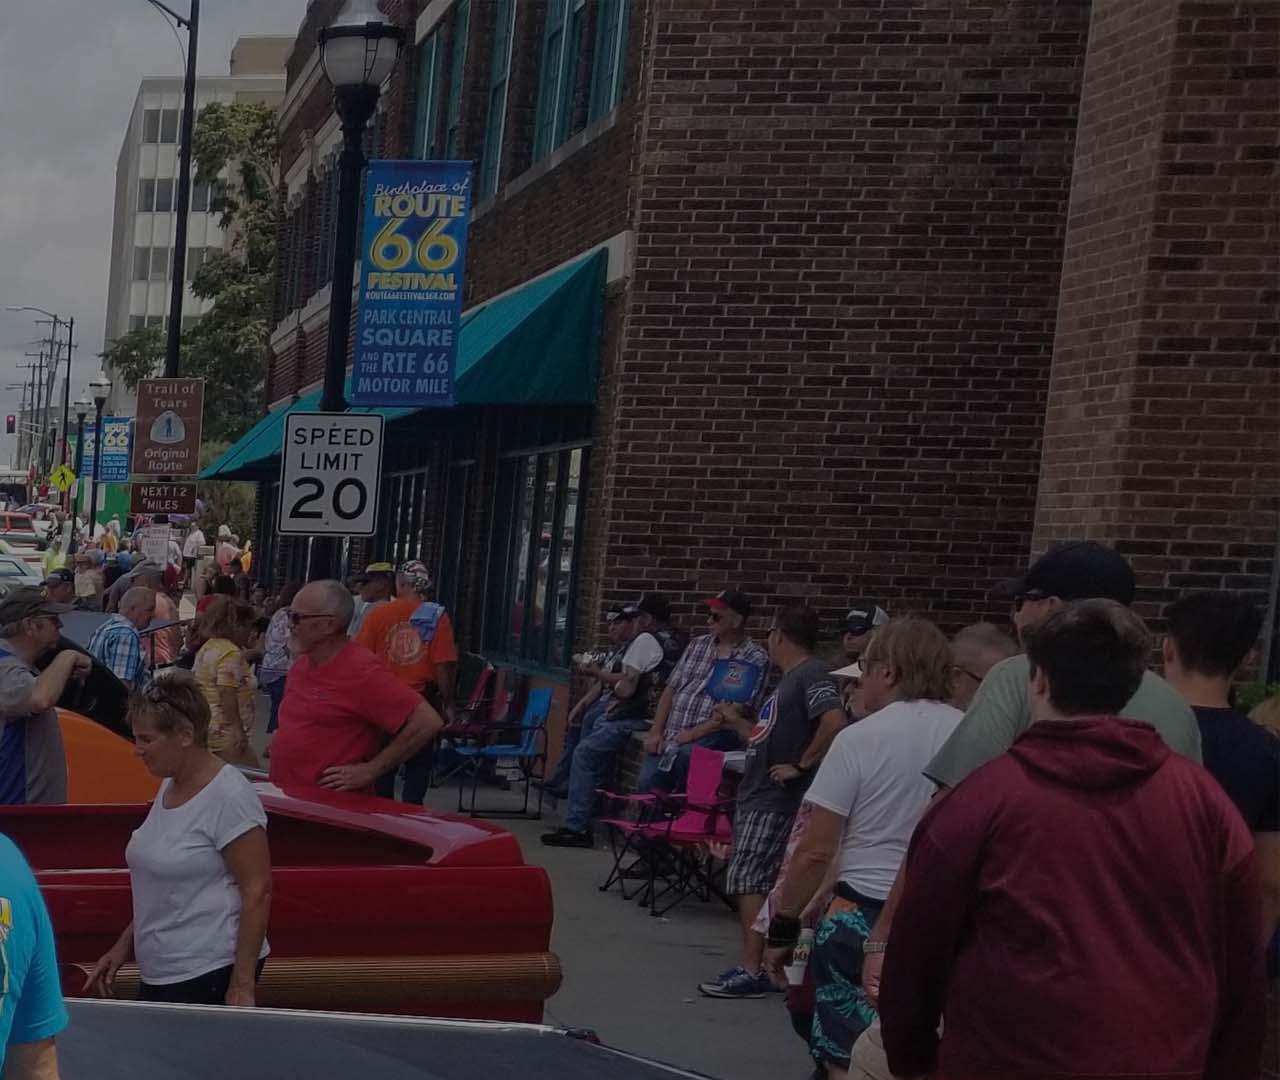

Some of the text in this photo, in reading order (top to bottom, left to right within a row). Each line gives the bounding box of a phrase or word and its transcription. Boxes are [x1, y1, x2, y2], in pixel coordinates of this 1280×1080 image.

[374, 177, 471, 195] Birthplace of
[373, 194, 466, 218] ROUTE
[370, 218, 459, 271] 66
[366, 272, 458, 291] FESTIVAL
[364, 309, 454, 325] PARK CENTRAL
[362, 328, 453, 346] SQUARE
[361, 352, 379, 361] AND
[382, 352, 449, 374] RTE 66
[360, 362, 378, 373] THE
[146, 383, 195, 394] Trail of
[358, 378, 450, 394] MOTOR MILE
[153, 399, 188, 409] Tears
[293, 427, 375, 447] SPEED
[144, 449, 190, 462] Original
[300, 452, 364, 471] LIMIT
[148, 460, 183, 471] Route
[140, 486, 168, 497] NEXT
[289, 476, 368, 521] 20
[146, 501, 179, 511] MILES
